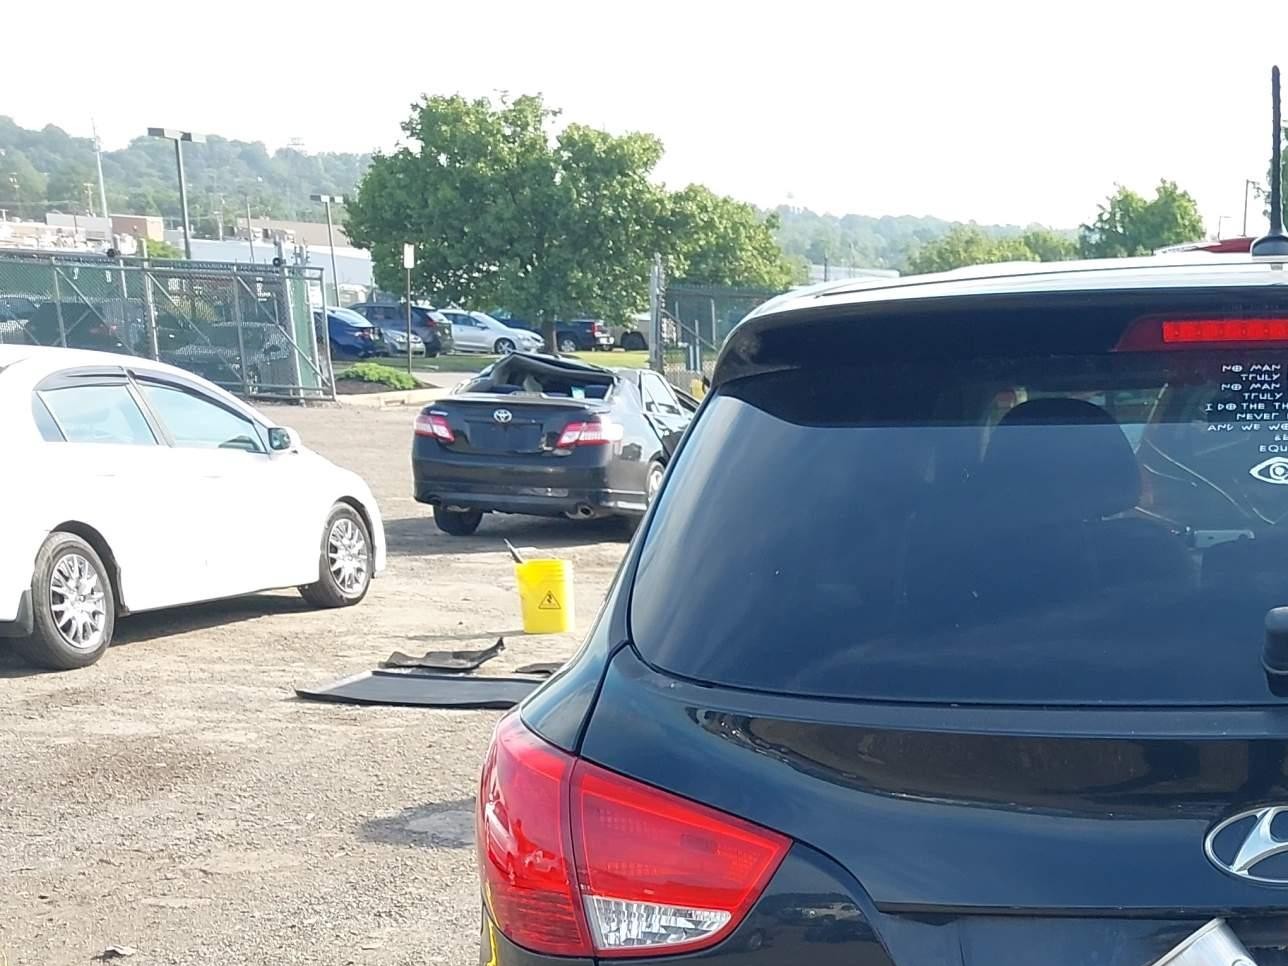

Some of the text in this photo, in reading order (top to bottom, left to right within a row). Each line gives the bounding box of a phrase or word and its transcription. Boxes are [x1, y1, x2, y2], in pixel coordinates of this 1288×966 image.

[1222, 364, 1243, 372] NO
[1250, 364, 1281, 372] MAN
[1240, 373, 1281, 381] TRULY
[1221, 383, 1242, 391] NO
[1242, 392, 1283, 400] TRULY
[1204, 402, 1213, 411] I
[1217, 402, 1237, 411] DO
[1240, 402, 1265, 410] THE
[1236, 412, 1280, 421] NEVER
[1207, 423, 1234, 432] AND
[1241, 423, 1261, 431] WE
